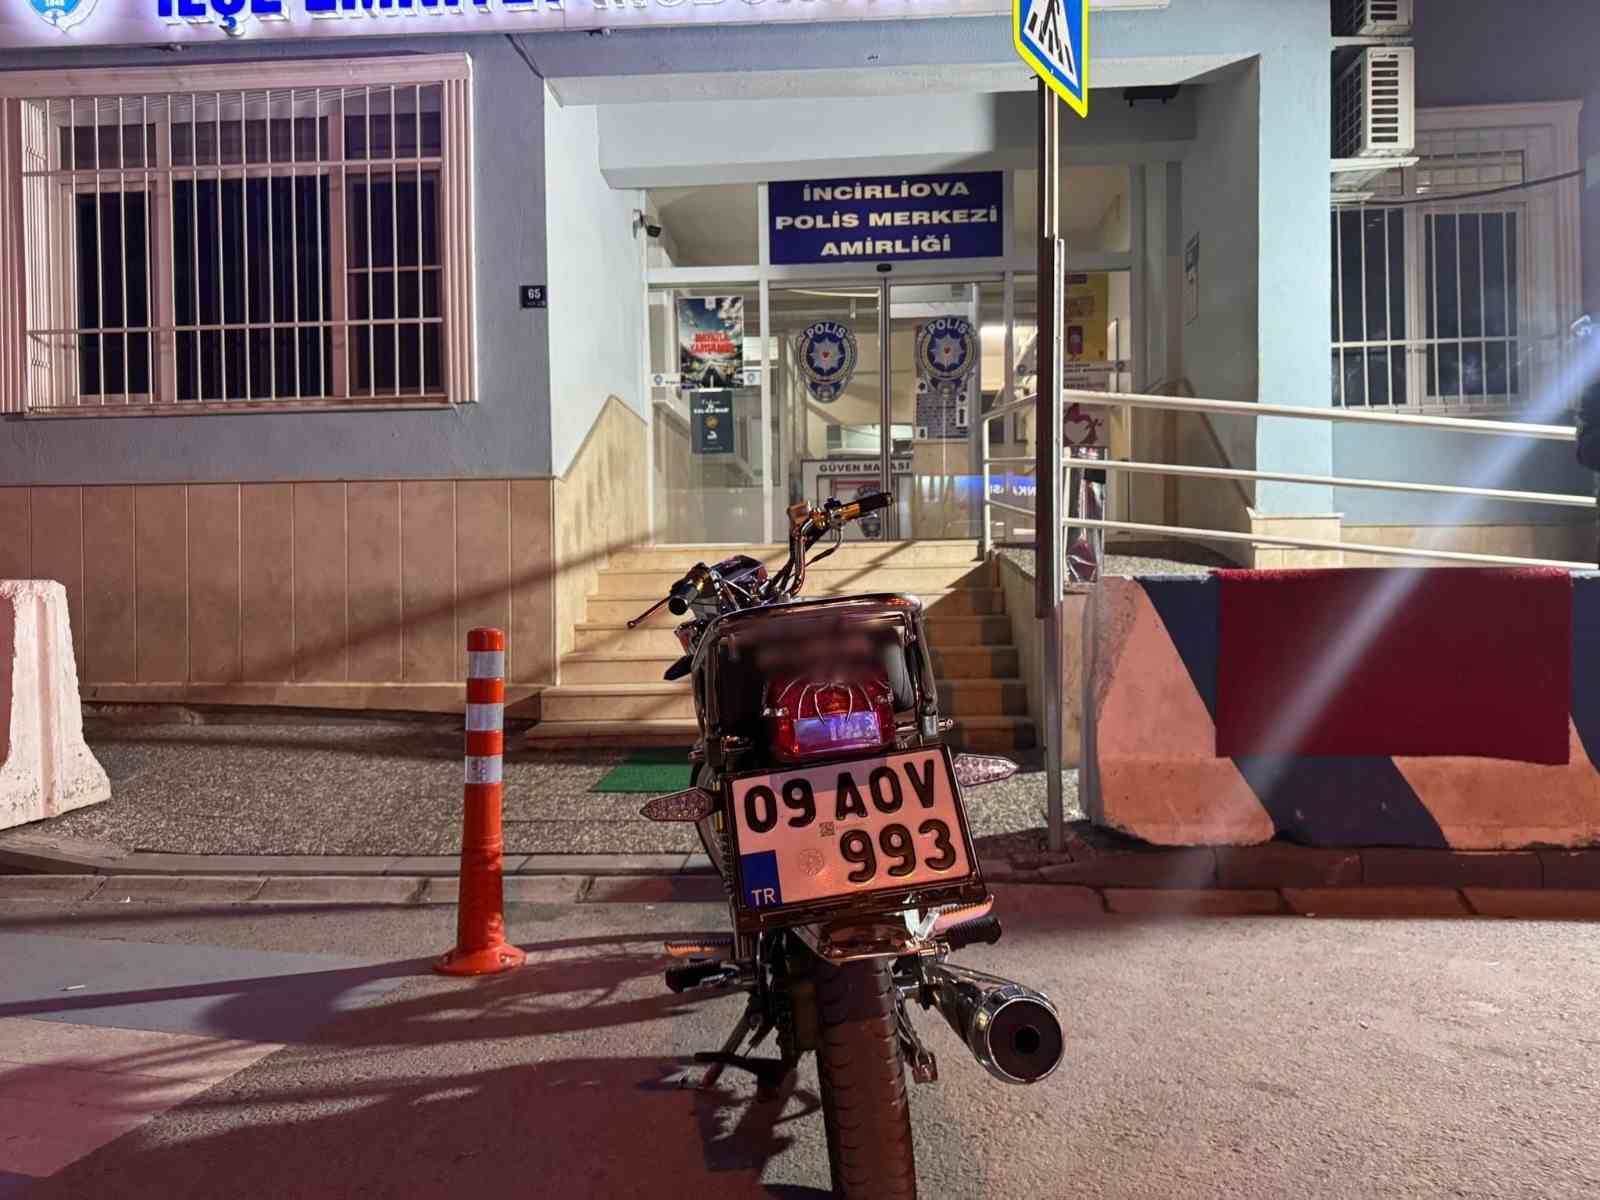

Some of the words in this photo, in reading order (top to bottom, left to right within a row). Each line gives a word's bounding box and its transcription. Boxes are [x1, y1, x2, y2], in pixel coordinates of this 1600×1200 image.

[803, 180, 970, 201] İNCİRLİOVA
[775, 210, 860, 230] POLİS
[869, 205, 998, 227] MERKEZİ
[820, 233, 950, 256] AMİRLİĞİ
[819, 463, 860, 473] GÜVEN
[743, 777, 817, 834] 09
[835, 759, 935, 821] AOV
[839, 818, 957, 884] 993
[751, 887, 776, 906] TR
